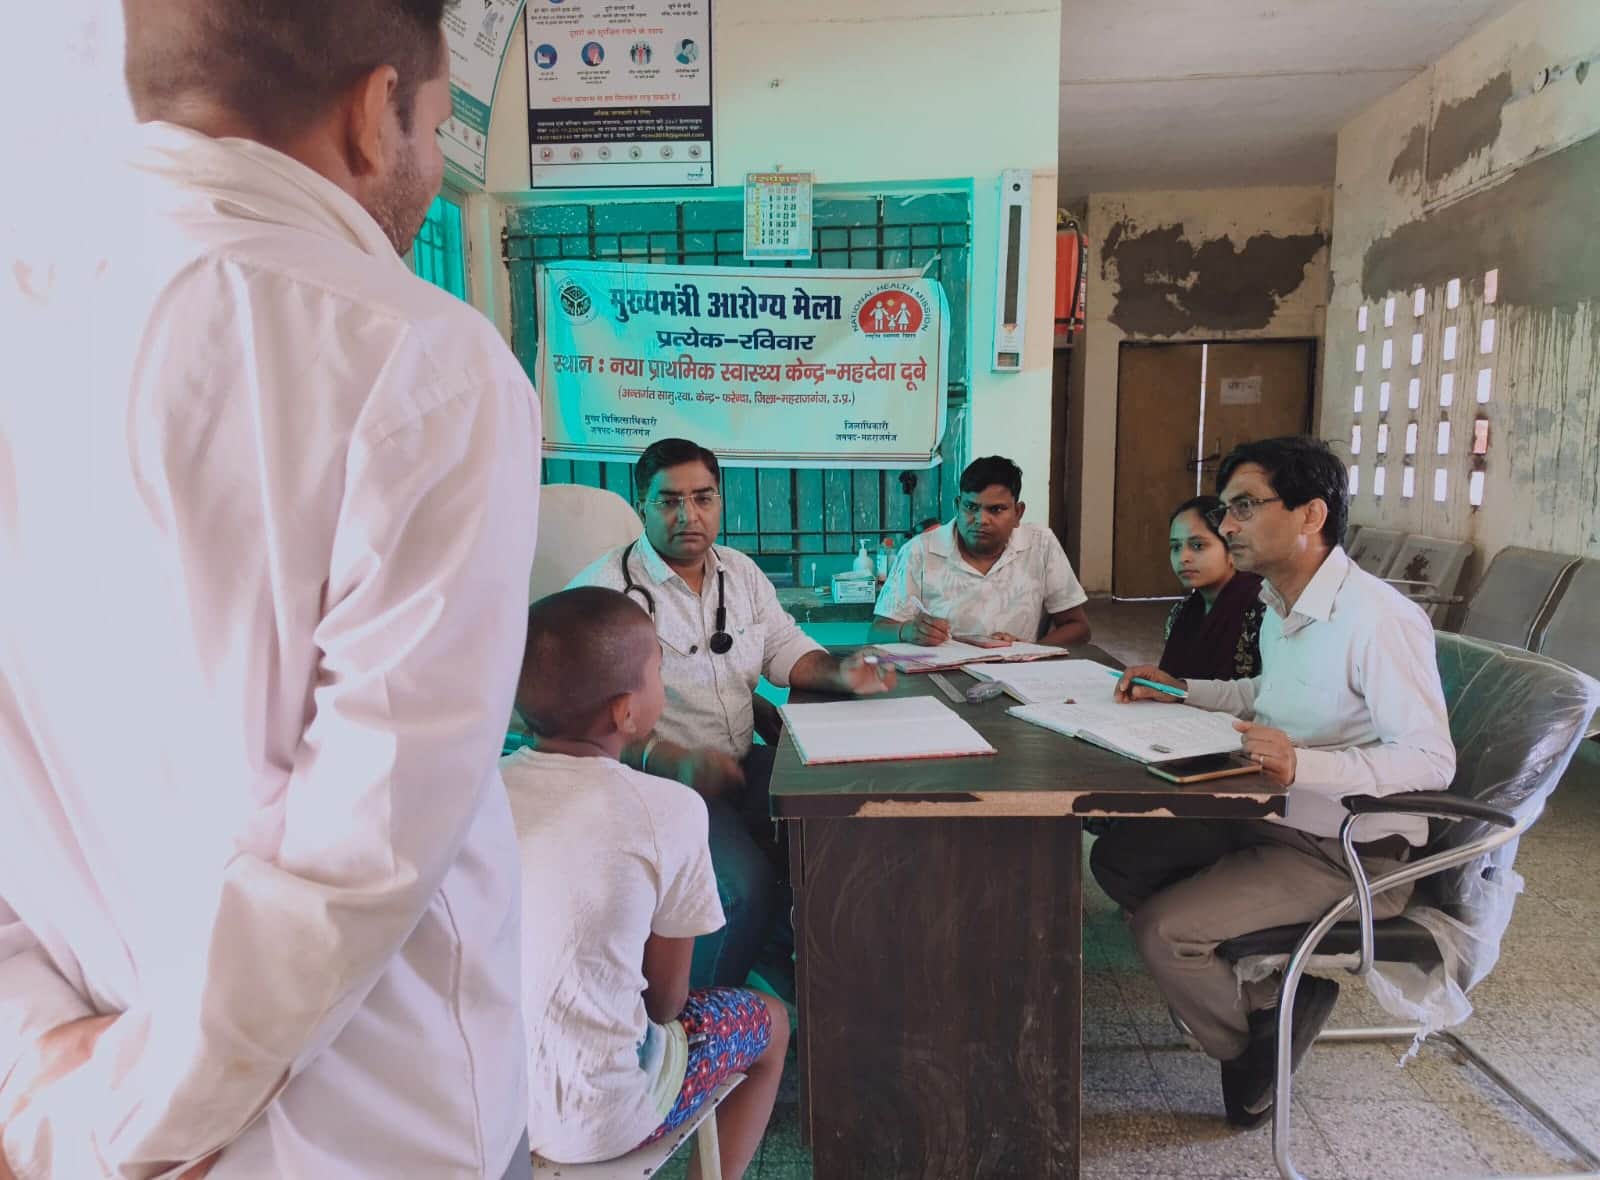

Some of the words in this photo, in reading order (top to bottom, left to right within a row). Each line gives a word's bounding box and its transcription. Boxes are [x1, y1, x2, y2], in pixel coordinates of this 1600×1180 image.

[611, 283, 701, 323] मुख्यमंत्री
[707, 285, 787, 320] आरोग्य
[792, 287, 842, 320] मेला
[850, 290, 873, 332] NATIONAL
[876, 282, 914, 293] HEALTH
[914, 290, 931, 332] MISSION
[656, 326, 817, 351] प्रत्येक-रविवार
[610, 358, 645, 377] नया
[649, 354, 717, 382] प्राथमिक
[720, 362, 782, 383] स्वास्थ्य
[900, 356, 928, 392] दूबे
